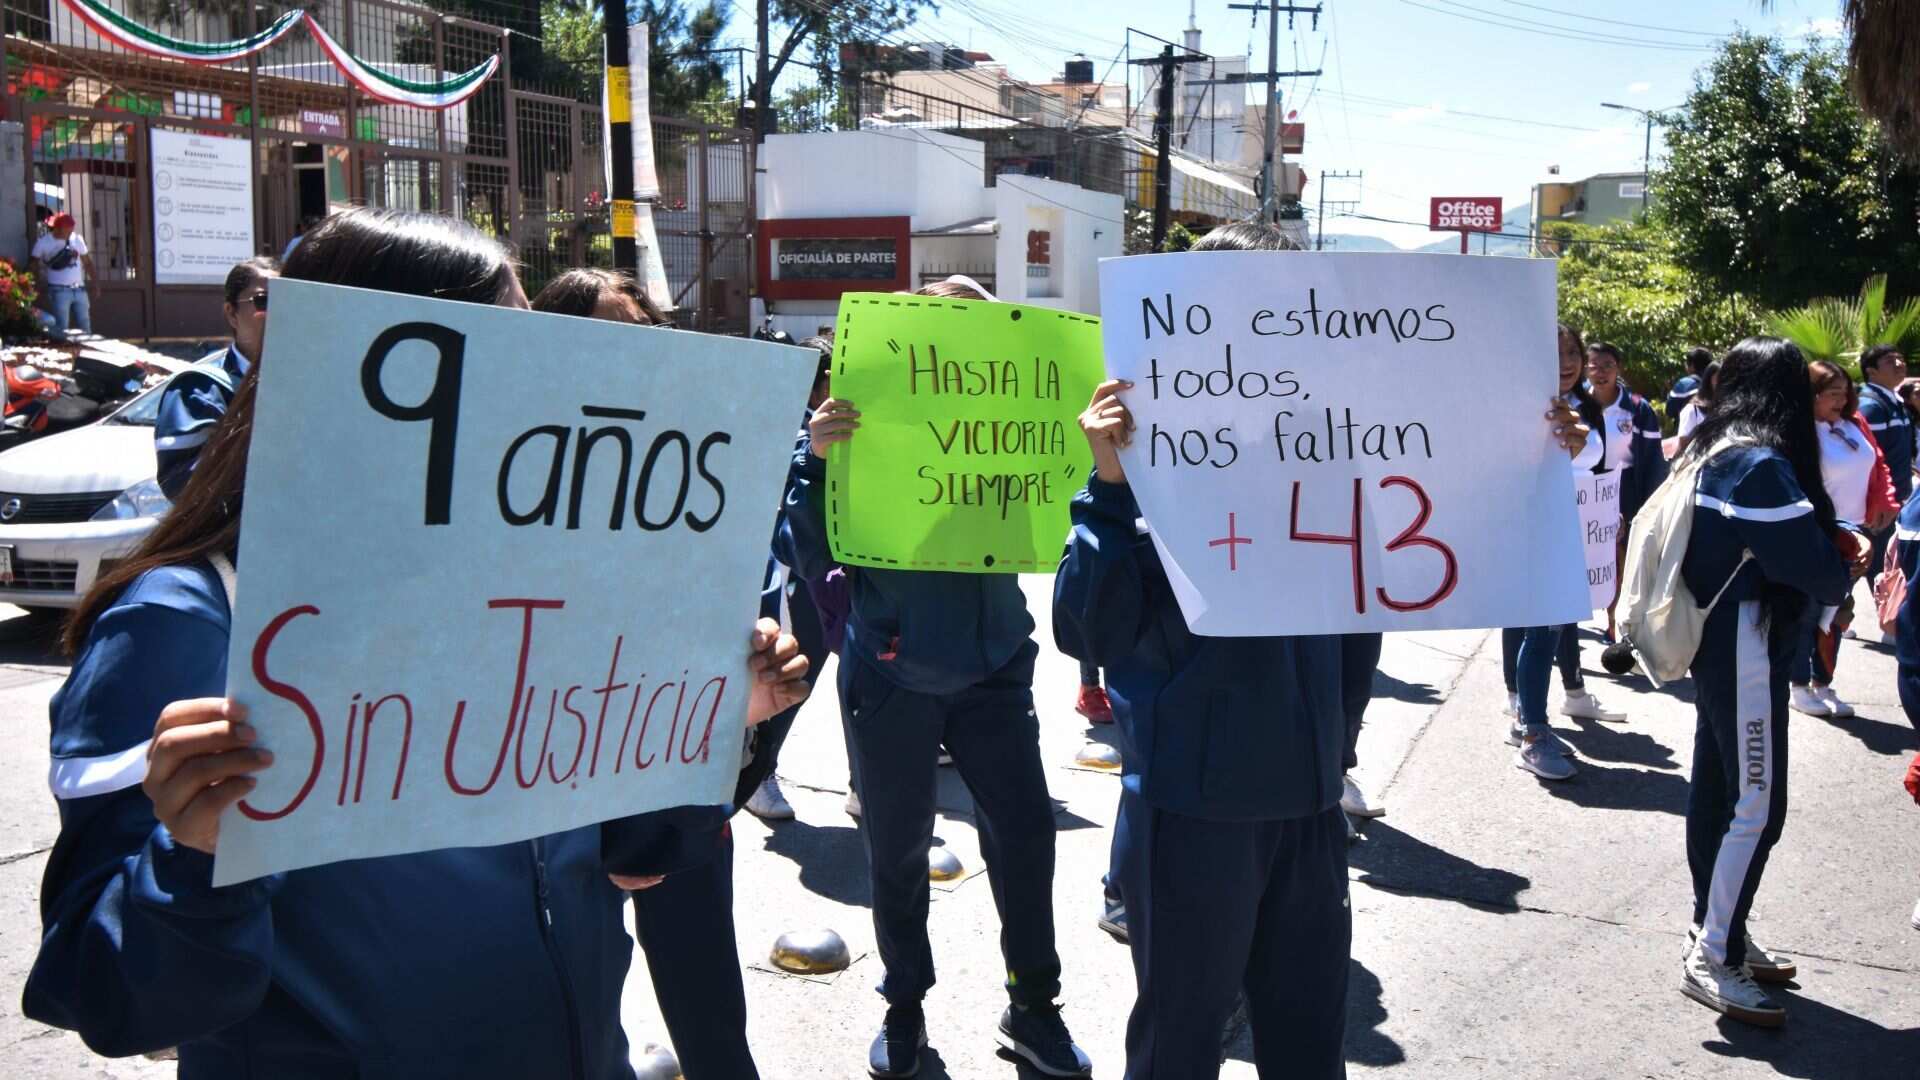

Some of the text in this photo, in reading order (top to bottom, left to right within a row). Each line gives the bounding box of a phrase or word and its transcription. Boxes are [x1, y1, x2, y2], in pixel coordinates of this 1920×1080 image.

[304, 111, 340, 126] ENTRADA
[1438, 202, 1495, 216] Office
[1438, 217, 1495, 227] DEPOT
[779, 250, 834, 264] OFICIALÍA
[836, 253, 852, 263] DE
[1142, 288, 1455, 342] No estamos
[1035, 357, 1060, 400] LA
[360, 321, 732, 533] 9 años
[928, 420, 1065, 456] VICTORIA
[1151, 407, 1432, 468] nos faltan
[1290, 475, 1459, 614] 43
[237, 599, 728, 821] Sin Justicia
